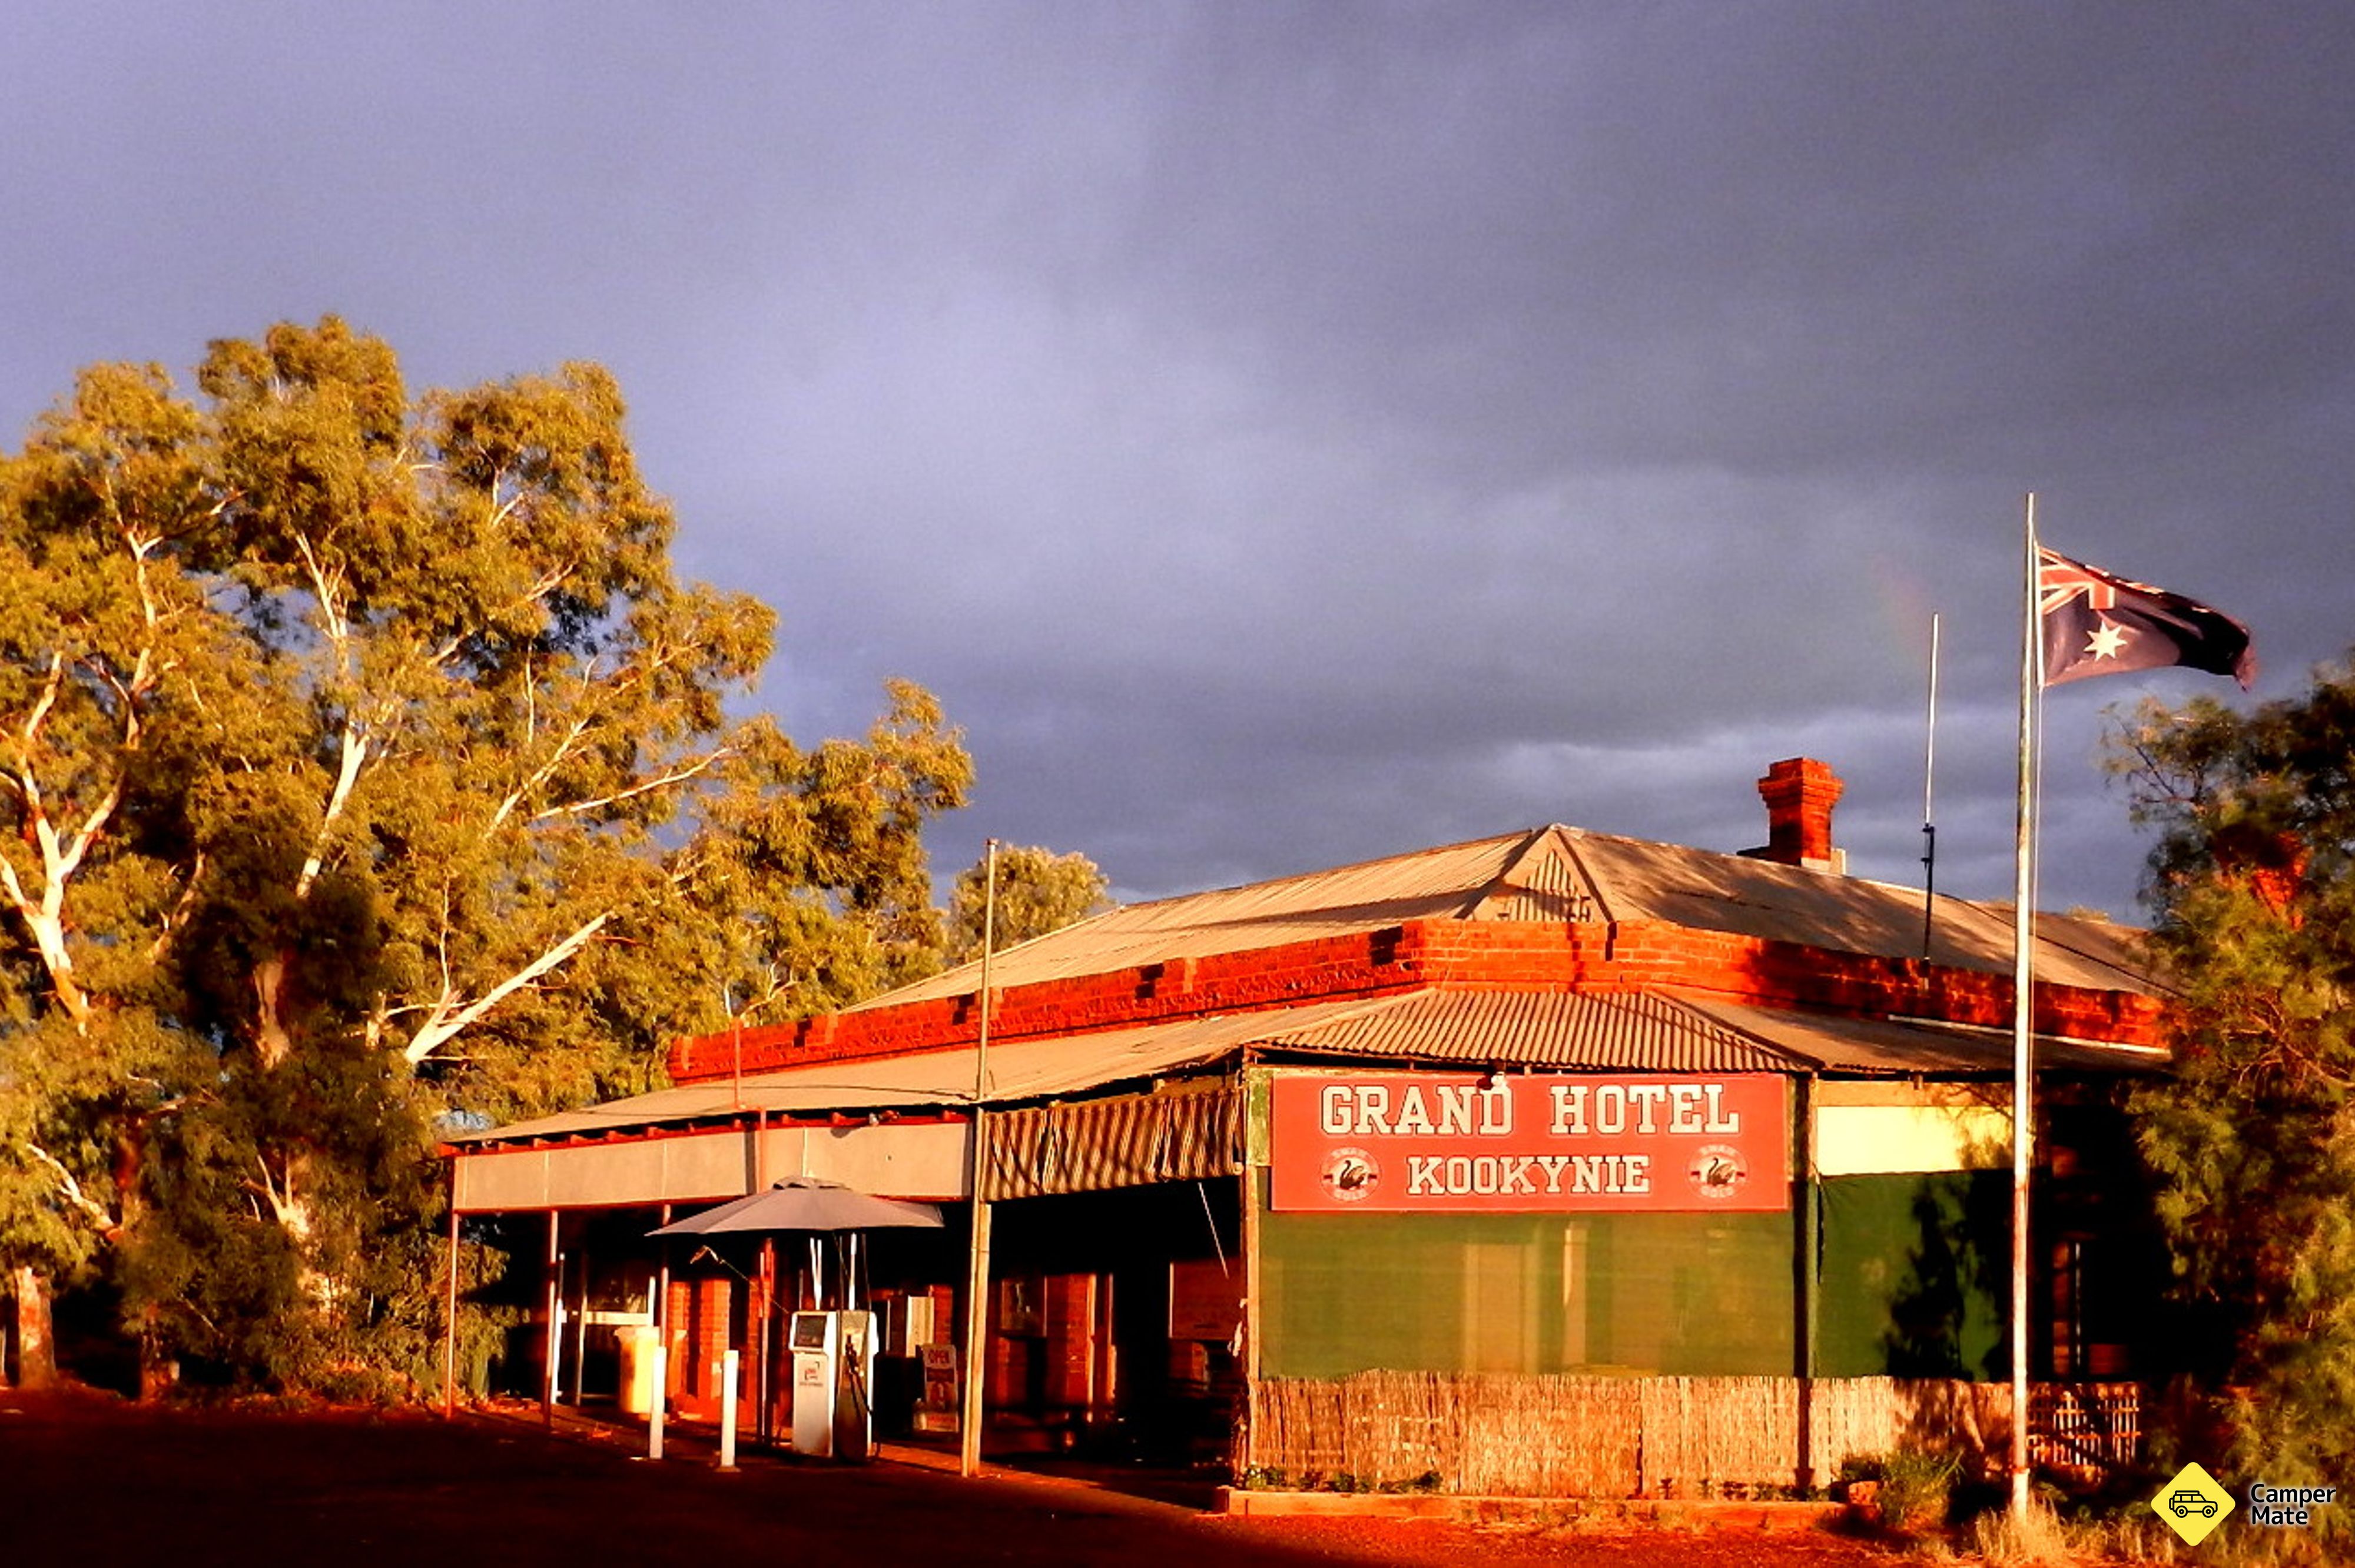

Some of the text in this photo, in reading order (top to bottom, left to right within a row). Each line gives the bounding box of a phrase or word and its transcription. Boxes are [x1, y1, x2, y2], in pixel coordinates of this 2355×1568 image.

[1322, 1084, 1740, 1135] GRAND HOTEL
[1407, 1155, 1650, 1194] KOOKYNIE
